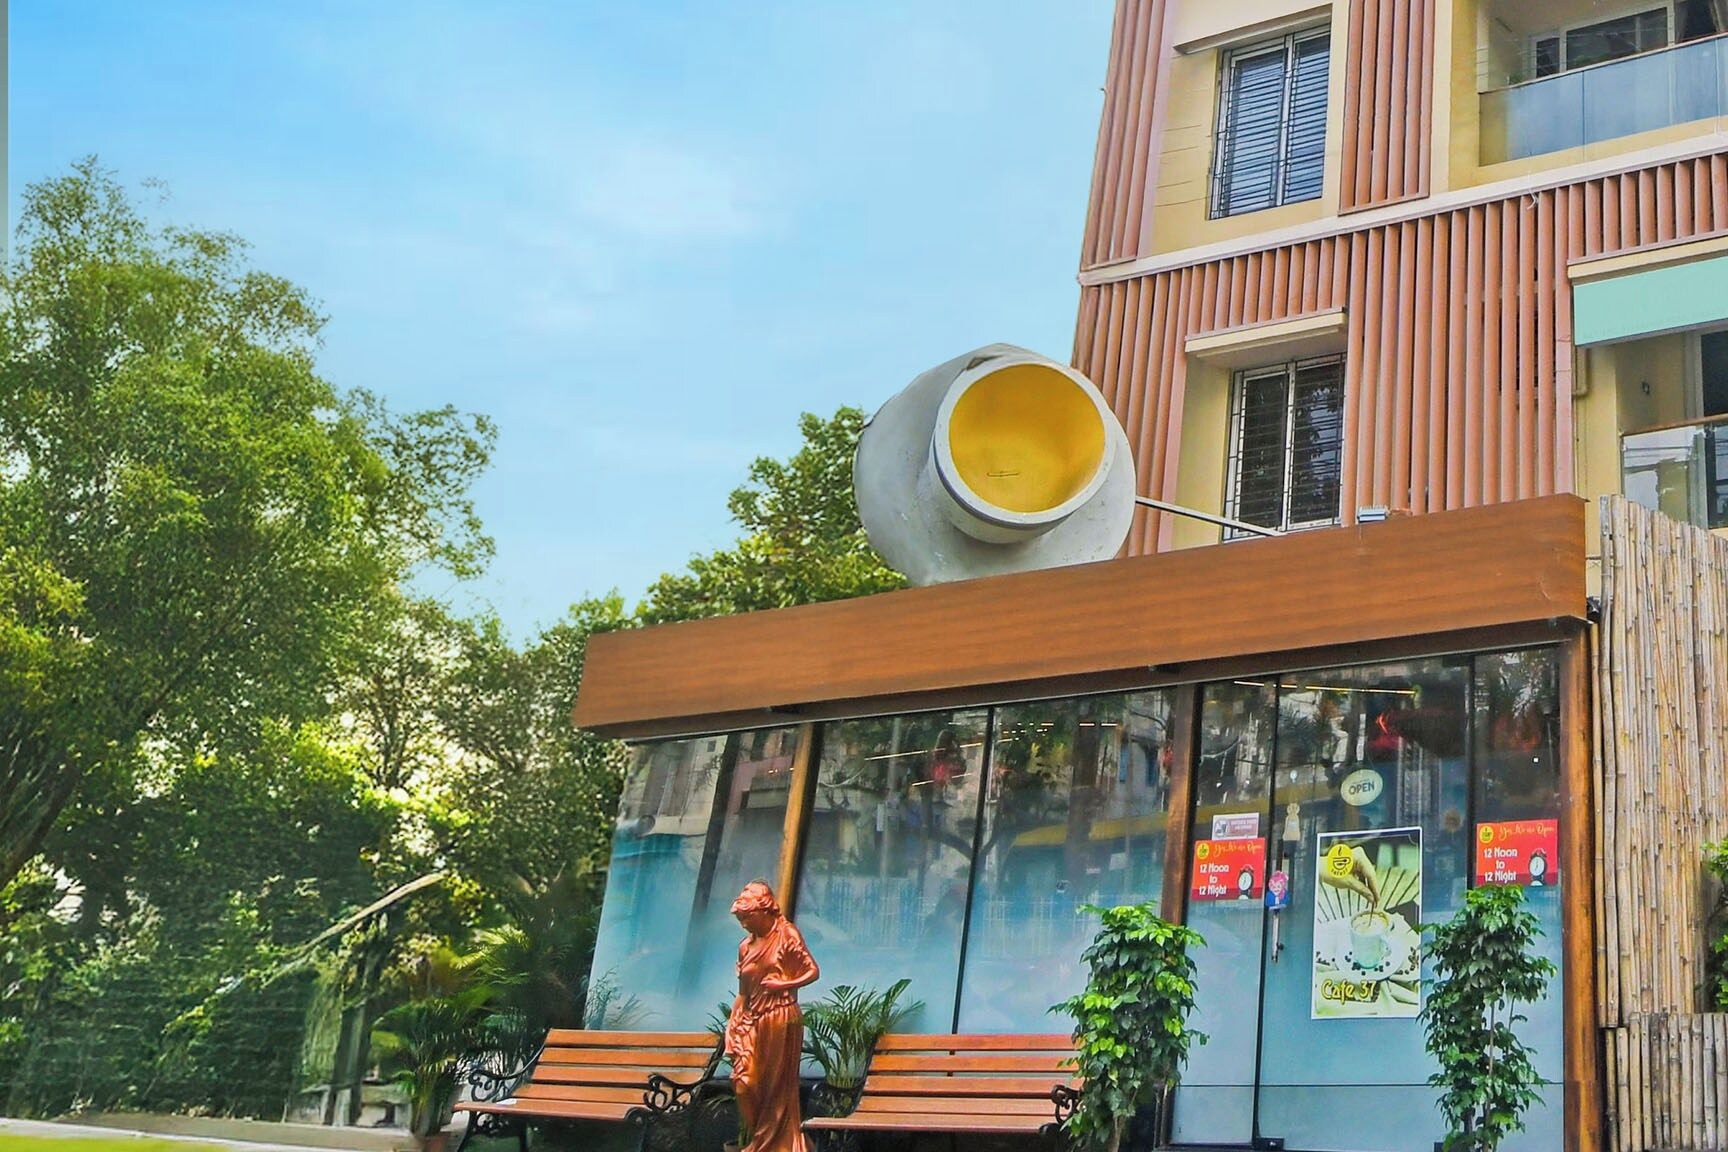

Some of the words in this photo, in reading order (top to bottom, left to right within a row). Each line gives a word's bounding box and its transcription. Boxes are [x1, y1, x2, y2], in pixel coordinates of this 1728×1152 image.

[1348, 780, 1375, 795] OPEN
[1484, 848, 1493, 858] 12
[1494, 846, 1518, 858] Noon
[1200, 863, 1207, 873] 12
[1208, 861, 1230, 873] Noon
[1495, 859, 1505, 869] to
[1209, 874, 1218, 884] to
[1484, 871, 1493, 881] 12
[1494, 869, 1517, 884] Night
[1198, 885, 1206, 895] 12
[1207, 884, 1227, 897] Night
[1321, 979, 1355, 1004] Cafe
[1360, 980, 1377, 998] 37
